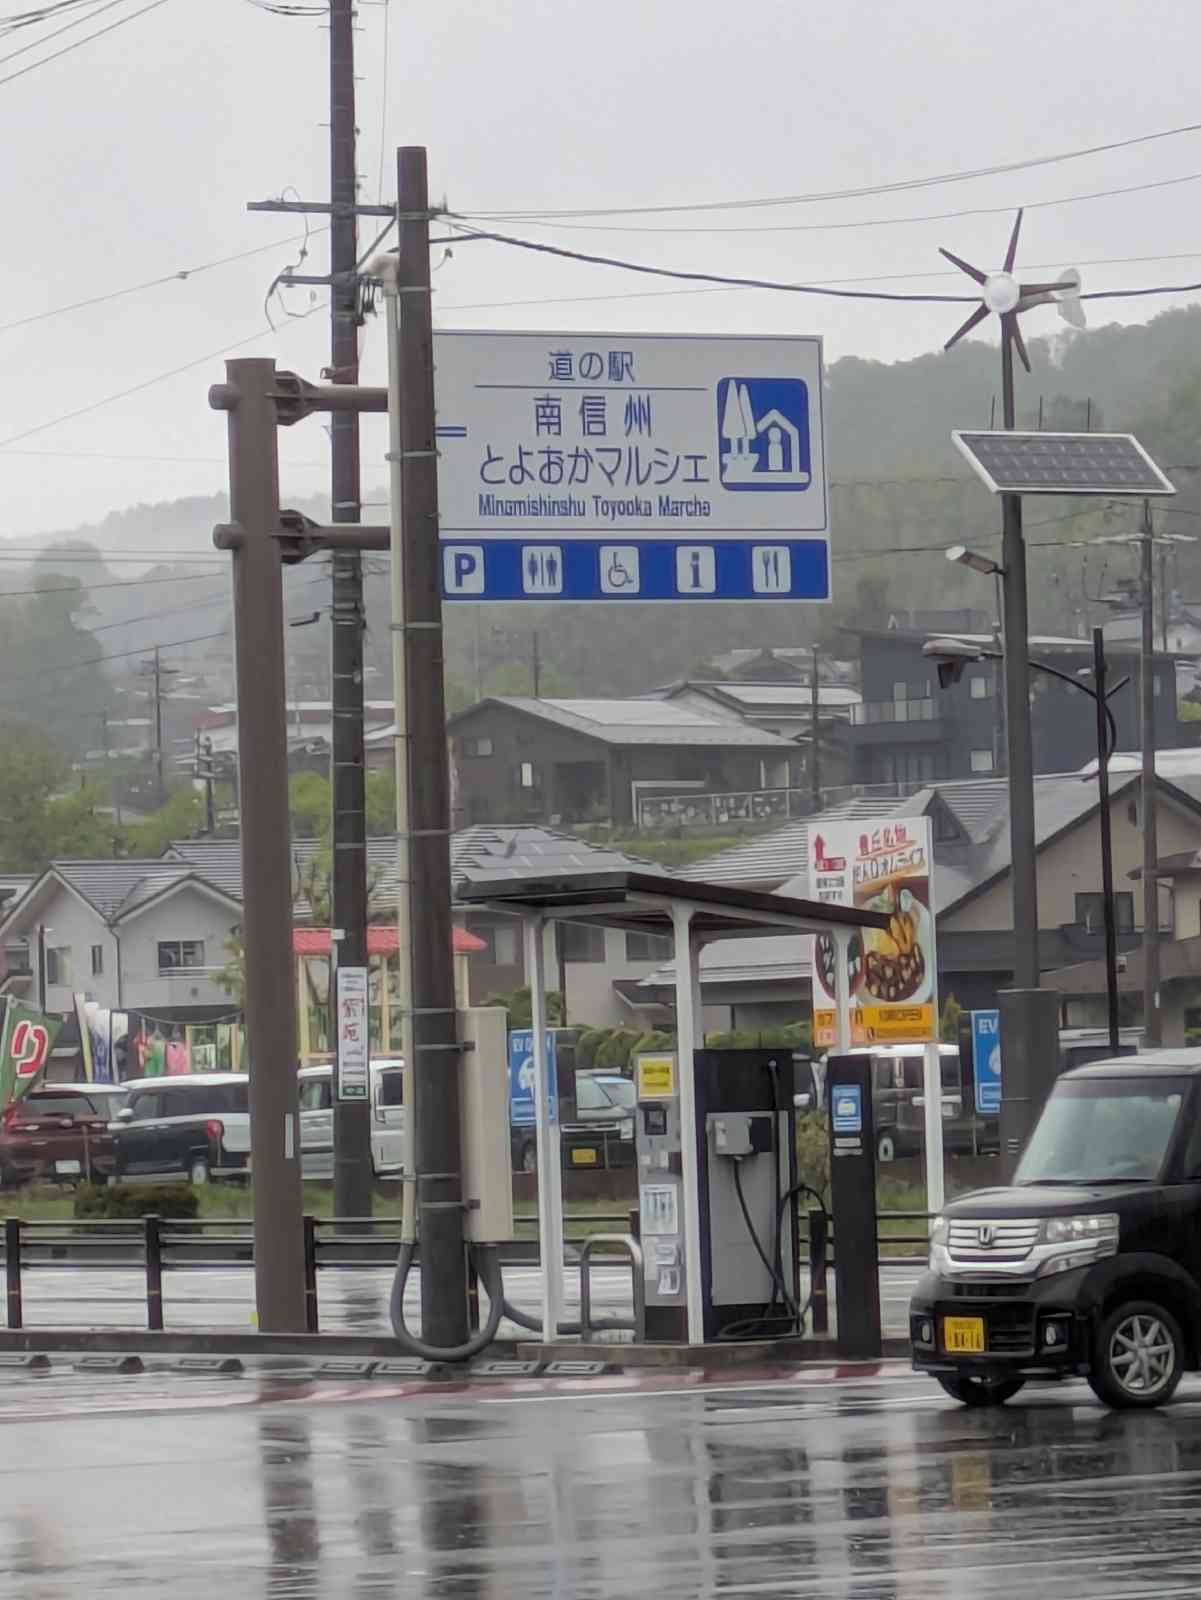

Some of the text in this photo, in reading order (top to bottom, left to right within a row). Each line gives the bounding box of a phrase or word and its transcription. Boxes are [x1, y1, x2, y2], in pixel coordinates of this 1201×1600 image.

[548, 351, 635, 382] 道の駅
[533, 395, 652, 437] 南信州
[479, 444, 710, 487] とよおかマルシェ
[478, 493, 711, 521] Minamishinshu Toyooka Marche
[454, 552, 476, 588] P
[979, 1019, 999, 1034] EV
